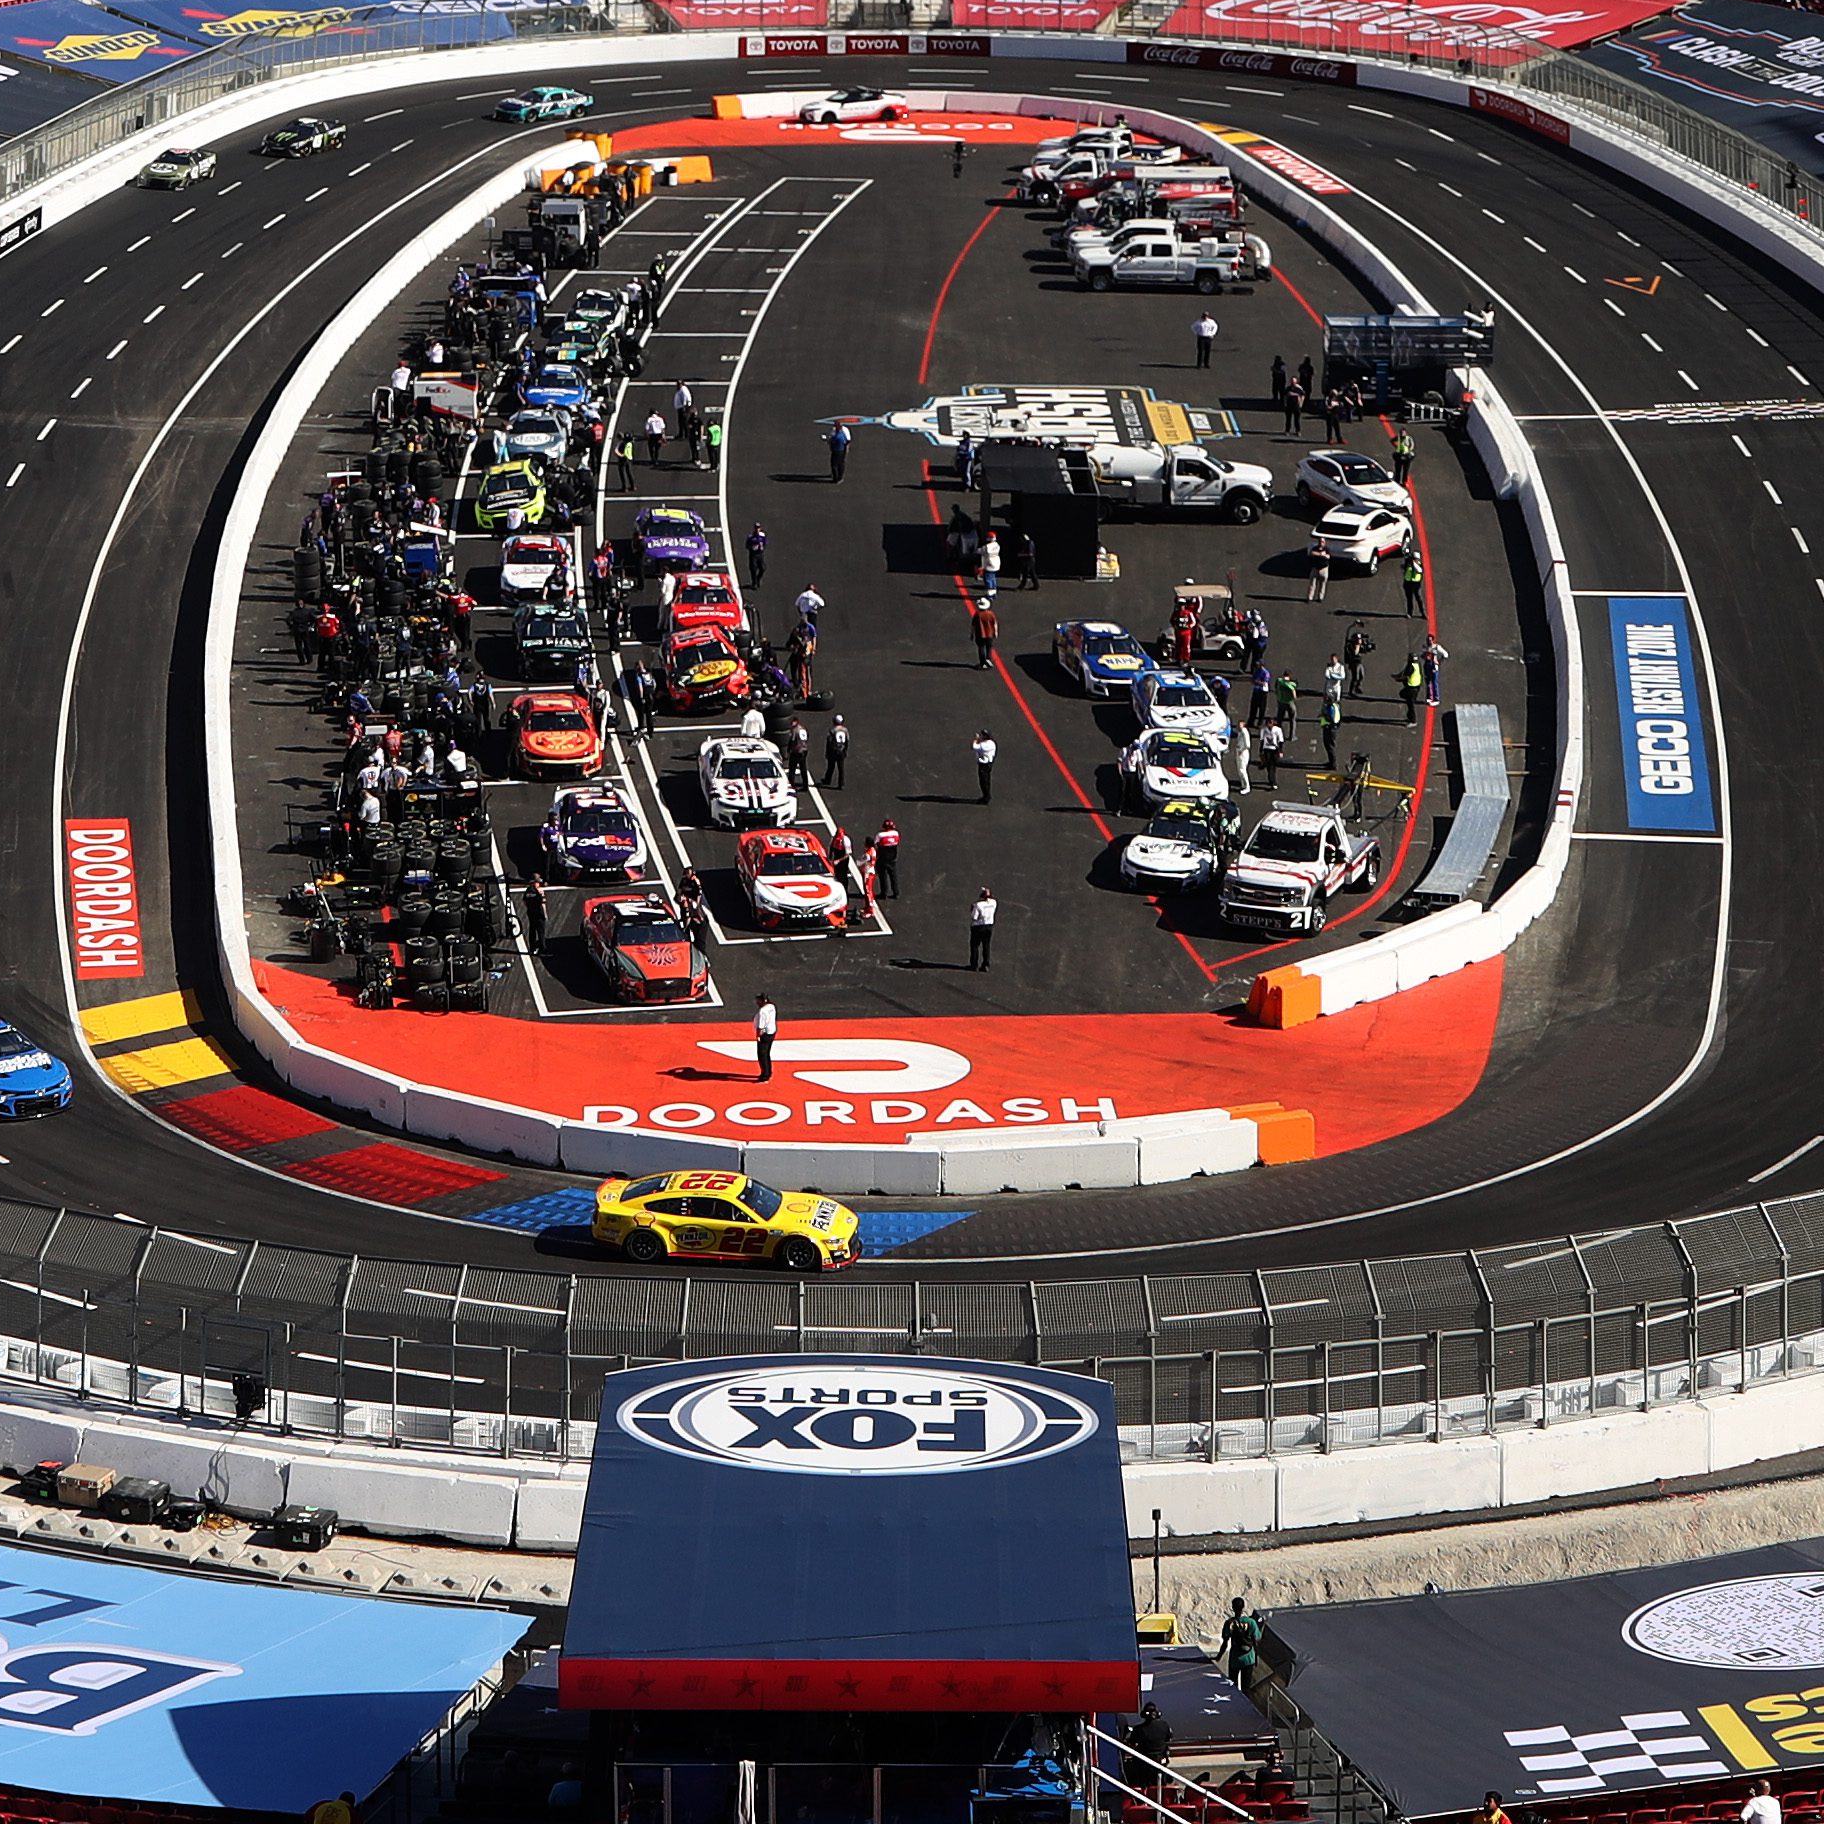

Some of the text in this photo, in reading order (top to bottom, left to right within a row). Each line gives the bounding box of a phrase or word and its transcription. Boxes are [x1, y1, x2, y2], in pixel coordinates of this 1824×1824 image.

[675, 4, 815, 17] TOYOTA
[968, 4, 1100, 16] TOYOTA
[202, 8, 350, 36] SUNOCO
[46, 31, 159, 62] SUNOCO
[769, 40, 819, 51] TOYOTA
[850, 39, 899, 51] TOYOTA
[931, 39, 981, 51] TOYOTA
[1668, 36, 1746, 68] CLASH
[1144, 46, 1201, 65] Coca-Cola
[1220, 51, 1274, 71] Coca-Cola
[1290, 59, 1341, 77] Coca-Cola
[678, 610, 735, 618] Motorcraft
[1626, 624, 1694, 795] GEICO RESTART ZONE
[567, 835, 633, 847] FedEx
[70, 829, 139, 967] DOORDASH
[1290, 912, 1302, 928] 2
[582, 1097, 1118, 1129] DOORDASH
[679, 1173, 740, 1190] 22
[676, 1231, 711, 1246] PENNZOIL
[718, 1227, 769, 1254] 22
[728, 1386, 988, 1406] SPORTS
[728, 1406, 987, 1452] FOX
